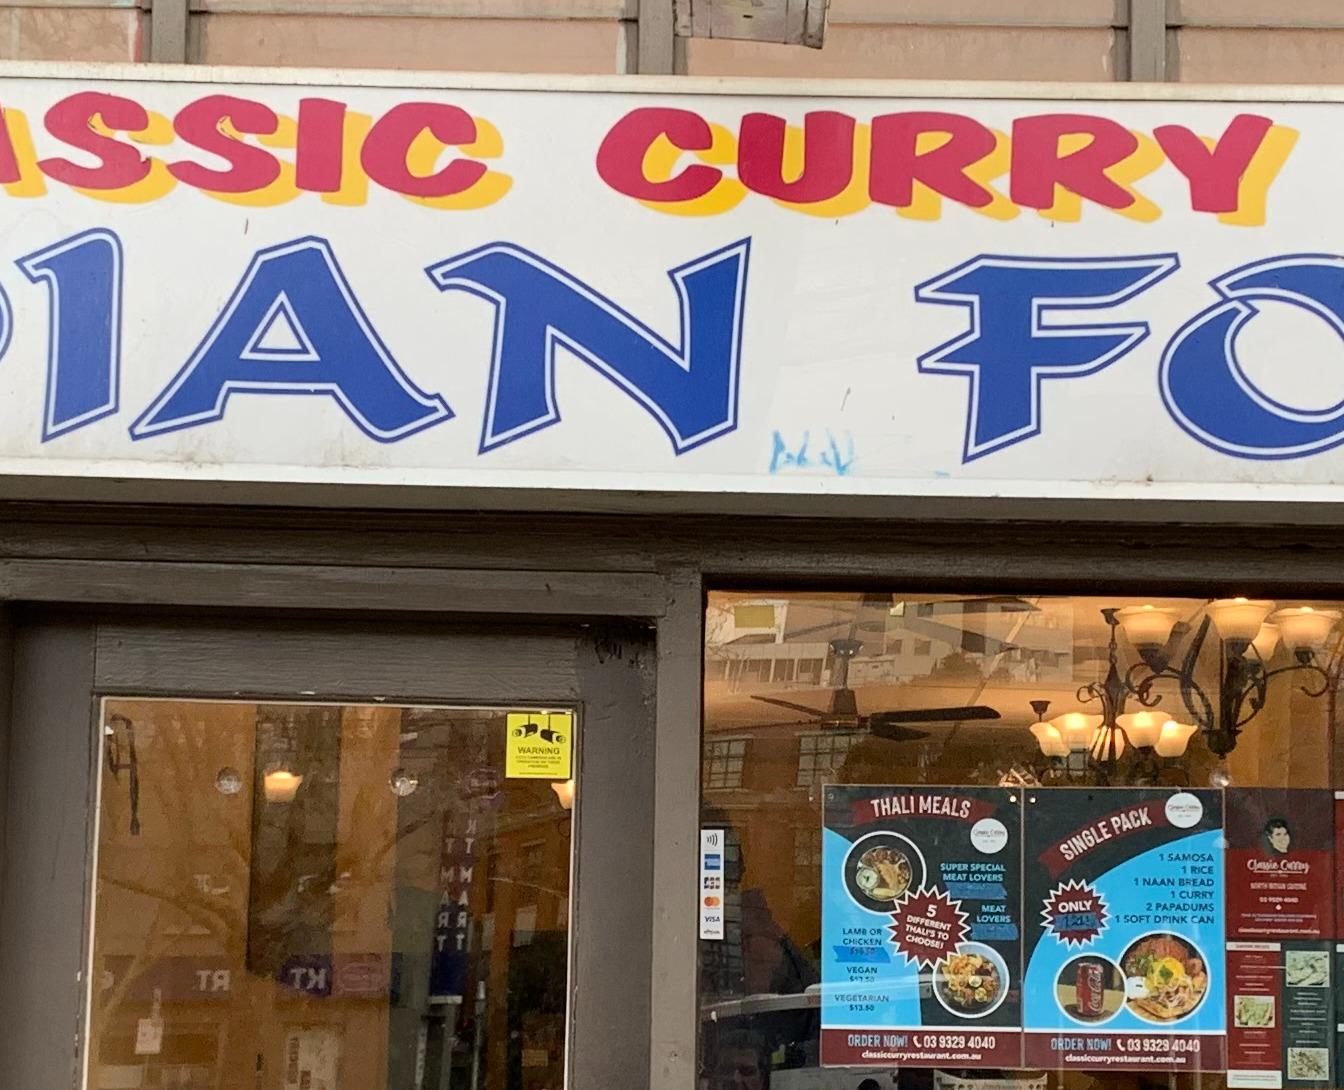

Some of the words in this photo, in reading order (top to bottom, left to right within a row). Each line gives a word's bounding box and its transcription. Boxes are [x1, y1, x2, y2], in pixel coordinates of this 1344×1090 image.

[596, 108, 1300, 226] CURRY
[518, 746, 560, 755] WARNING
[870, 796, 915, 818] THALI
[918, 796, 971, 818] MEALS
[1059, 821, 1113, 861] SINGLE
[1110, 807, 1152, 835] PACK
[1159, 853, 1164, 861] 1
[1167, 853, 1214, 862] SAMOSA
[940, 863, 968, 872] SUPER
[970, 863, 1006, 872] SPECIAL
[1181, 866, 1186, 874] 1
[1190, 866, 1214, 874] RICE
[943, 873, 967, 881] MEAT
[969, 873, 1003, 882] LOVERS
[1134, 878, 1139, 886] 1
[1142, 878, 1175, 886] NAAN
[1178, 878, 1214, 887] BREAD
[1171, 891, 1175, 899] 1
[1179, 891, 1214, 899] CURRY
[927, 904, 937, 917] 5
[981, 905, 1006, 913] MEAT
[1058, 900, 1093, 913] ONLY
[1146, 903, 1152, 911] 2
[1155, 903, 1214, 912] PAPADUMS
[906, 915, 952, 931] DIFFERENT
[977, 915, 1011, 923] LOVERS
[1115, 915, 1120, 923] 1
[1123, 915, 1150, 923] SOFT
[1153, 915, 1188, 924] DRINK
[1191, 915, 1214, 924] CAN
[842, 928, 867, 936] LAMB
[869, 928, 882, 936] OR
[906, 925, 936, 939] THALI'S
[937, 931, 949, 941] TO
[842, 938, 882, 946] CHICKEN
[905, 934, 944, 950] CHOOSE!
[846, 966, 877, 974] VEGAN
[834, 994, 889, 1003] VEGETARIAN
[848, 1034, 881, 1047] ORDER
[923, 1035, 937, 1048] 03
[939, 1036, 965, 1049] 9329
[967, 1036, 995, 1049] 4040
[1051, 1038, 1084, 1050] ORDER
[1127, 1039, 1140, 1051] 03
[1143, 1039, 1169, 1052] 9329
[1171, 1040, 1200, 1052] 4040
[861, 1050, 981, 1061] classiccurryrestaurant.com.au
[1065, 1053, 1186, 1064] classiccurryrestaurant.com.au
